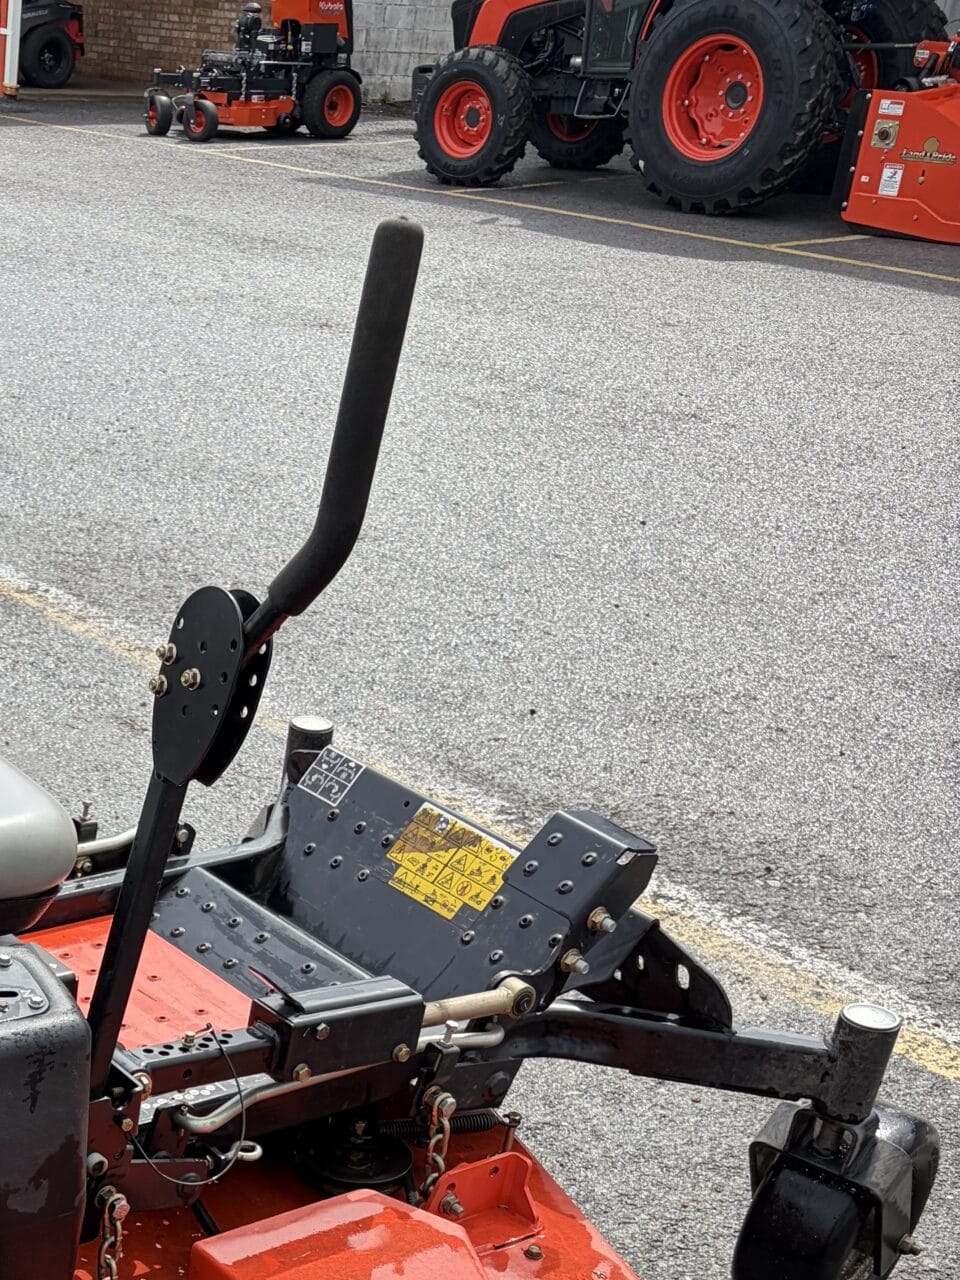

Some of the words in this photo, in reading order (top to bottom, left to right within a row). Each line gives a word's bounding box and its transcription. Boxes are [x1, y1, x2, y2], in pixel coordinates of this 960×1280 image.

[319, 1, 344, 10] Kubota
[901, 148, 926, 159] Land
[932, 151, 957, 162] Pride
